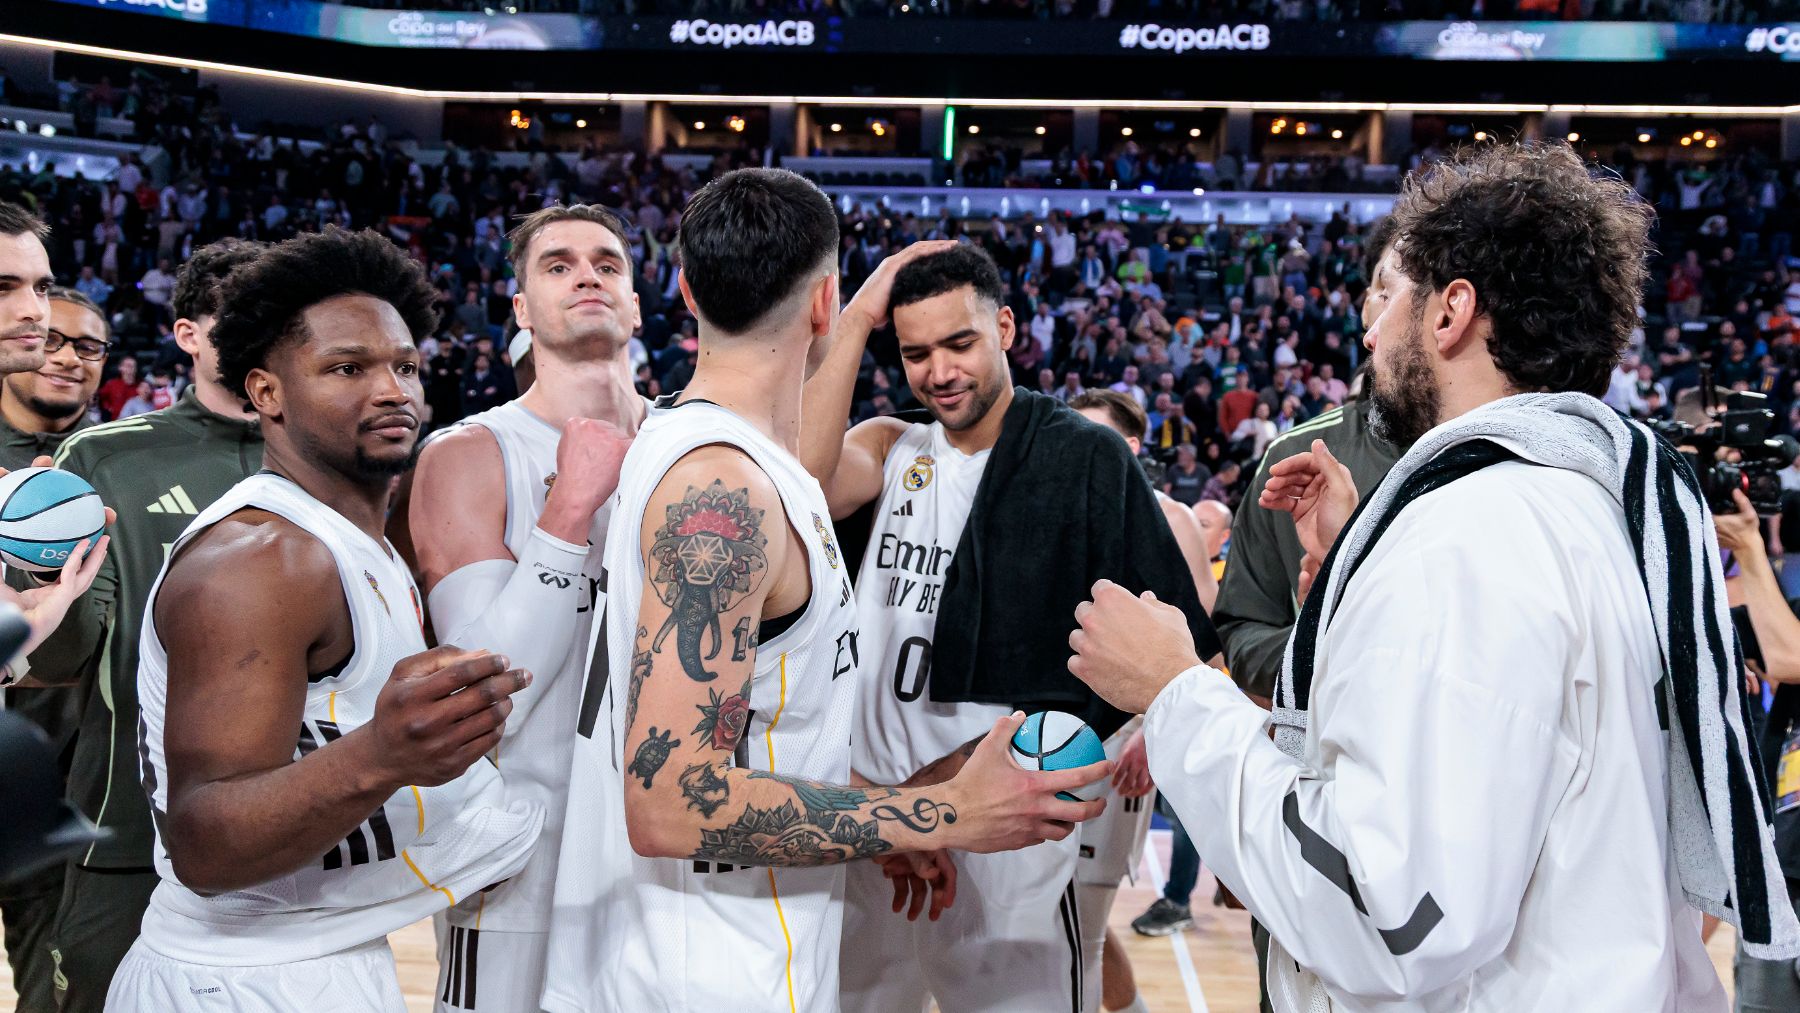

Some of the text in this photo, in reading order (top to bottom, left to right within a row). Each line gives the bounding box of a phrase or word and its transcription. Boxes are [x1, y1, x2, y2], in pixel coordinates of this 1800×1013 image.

[388, 18, 436, 35] Copa
[669, 18, 815, 49] #CopaACB
[1119, 23, 1271, 54] #CopaACB
[1510, 30, 1546, 51] Rey
[877, 533, 952, 575] Emir
[894, 636, 933, 703] 0
